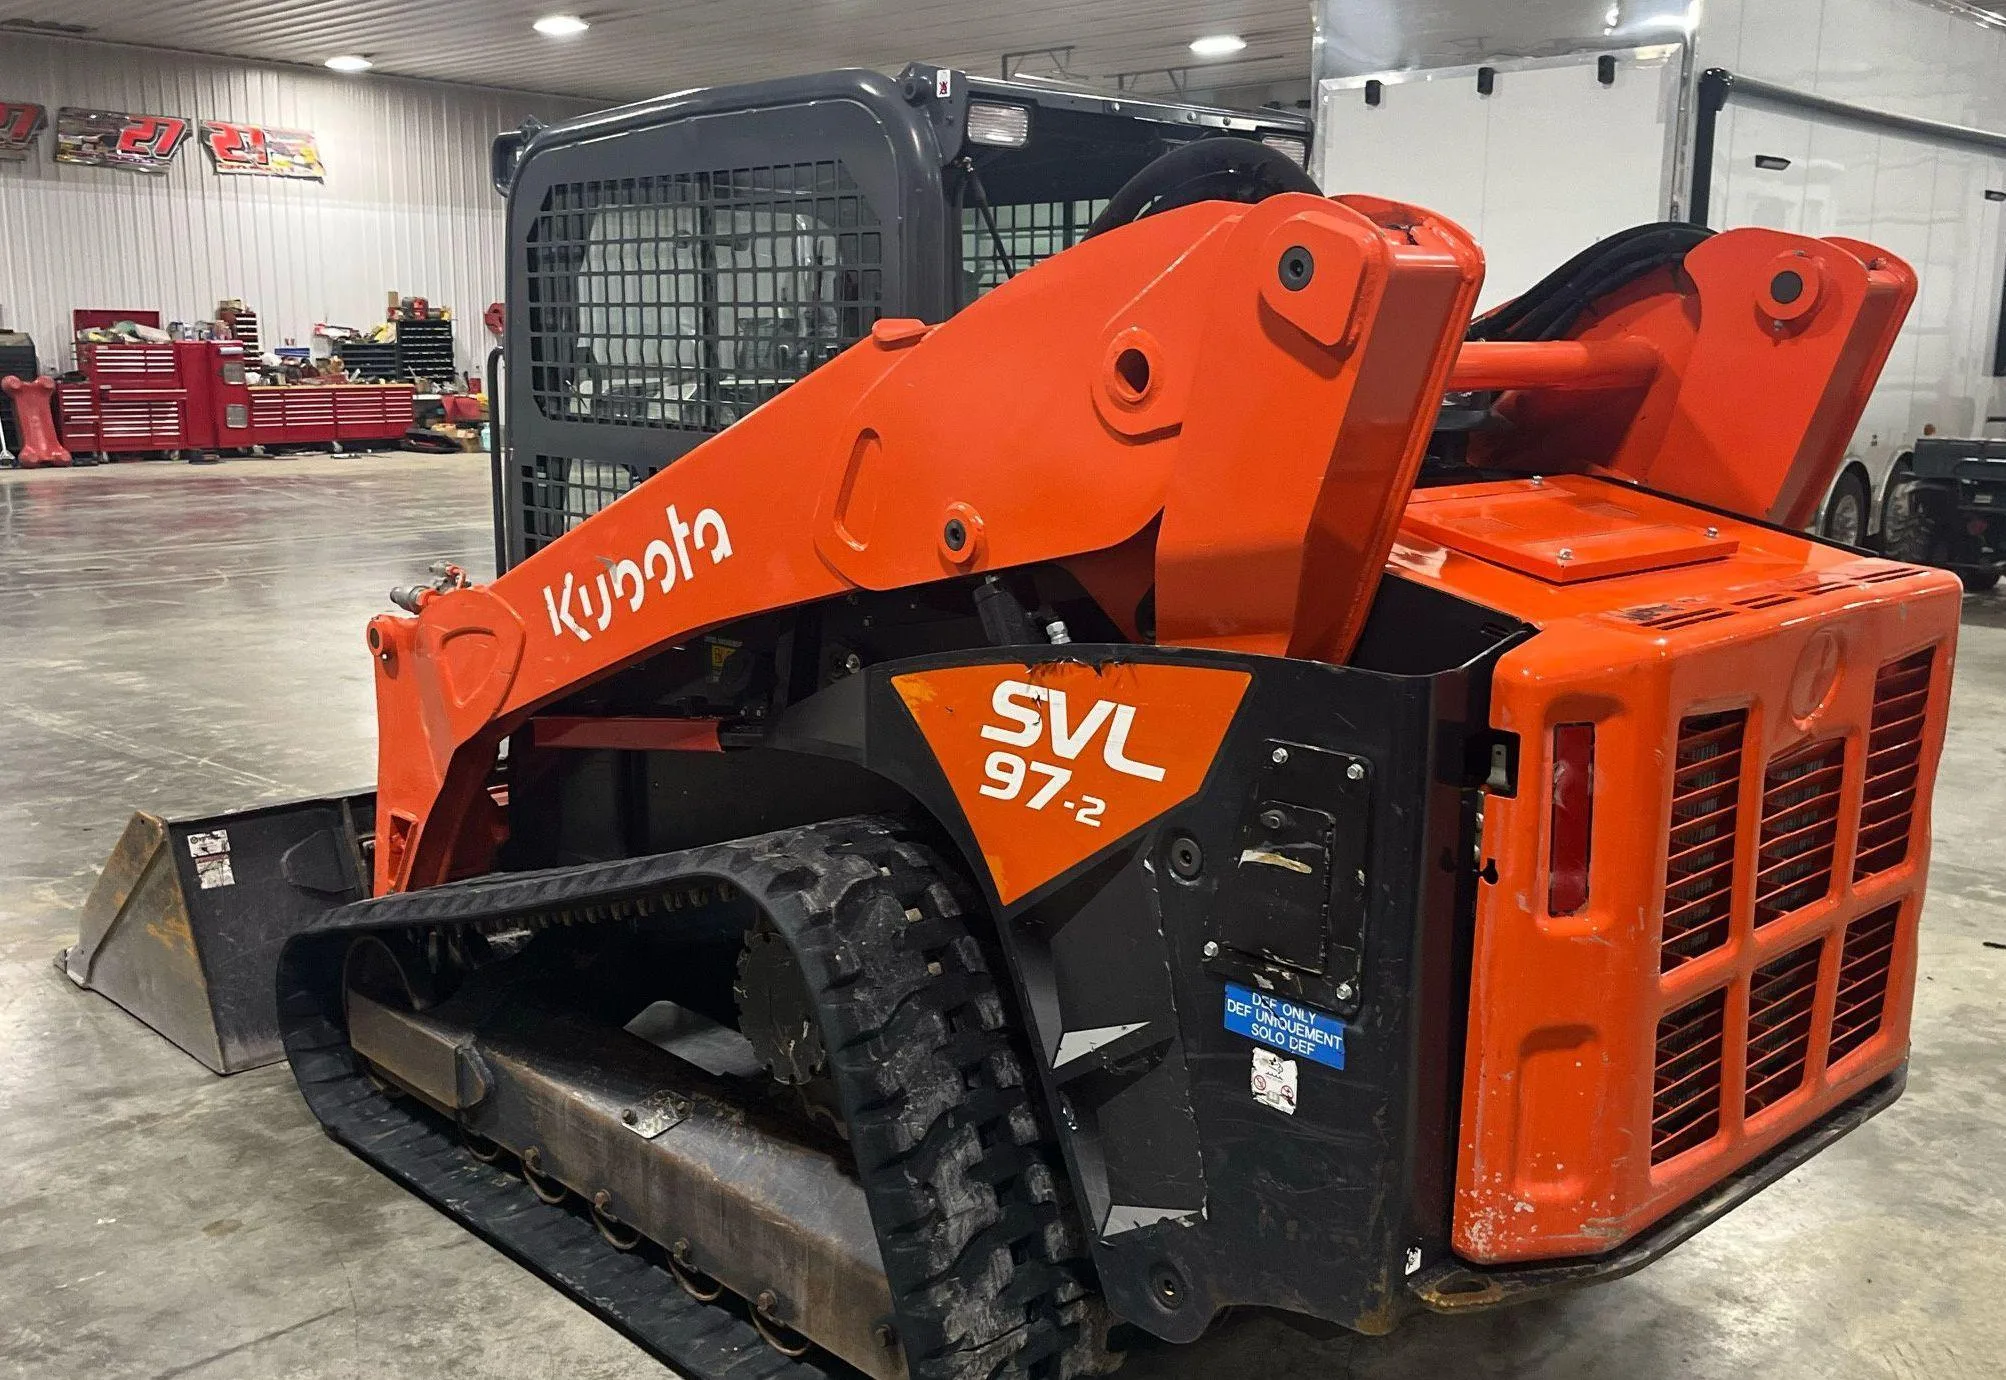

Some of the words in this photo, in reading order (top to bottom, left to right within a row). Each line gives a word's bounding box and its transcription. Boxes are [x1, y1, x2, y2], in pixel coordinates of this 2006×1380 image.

[0, 103, 41, 142] 7
[117, 114, 186, 157] 27
[543, 504, 734, 642] Kubota
[980, 680, 1167, 782] SVL
[979, 751, 1106, 828] 97-2
[1227, 998, 1252, 1017] DEF
[1282, 1003, 1317, 1025] ONLY
[1251, 1023, 1285, 1045] SOLO
[1289, 1036, 1316, 1056] DEF
